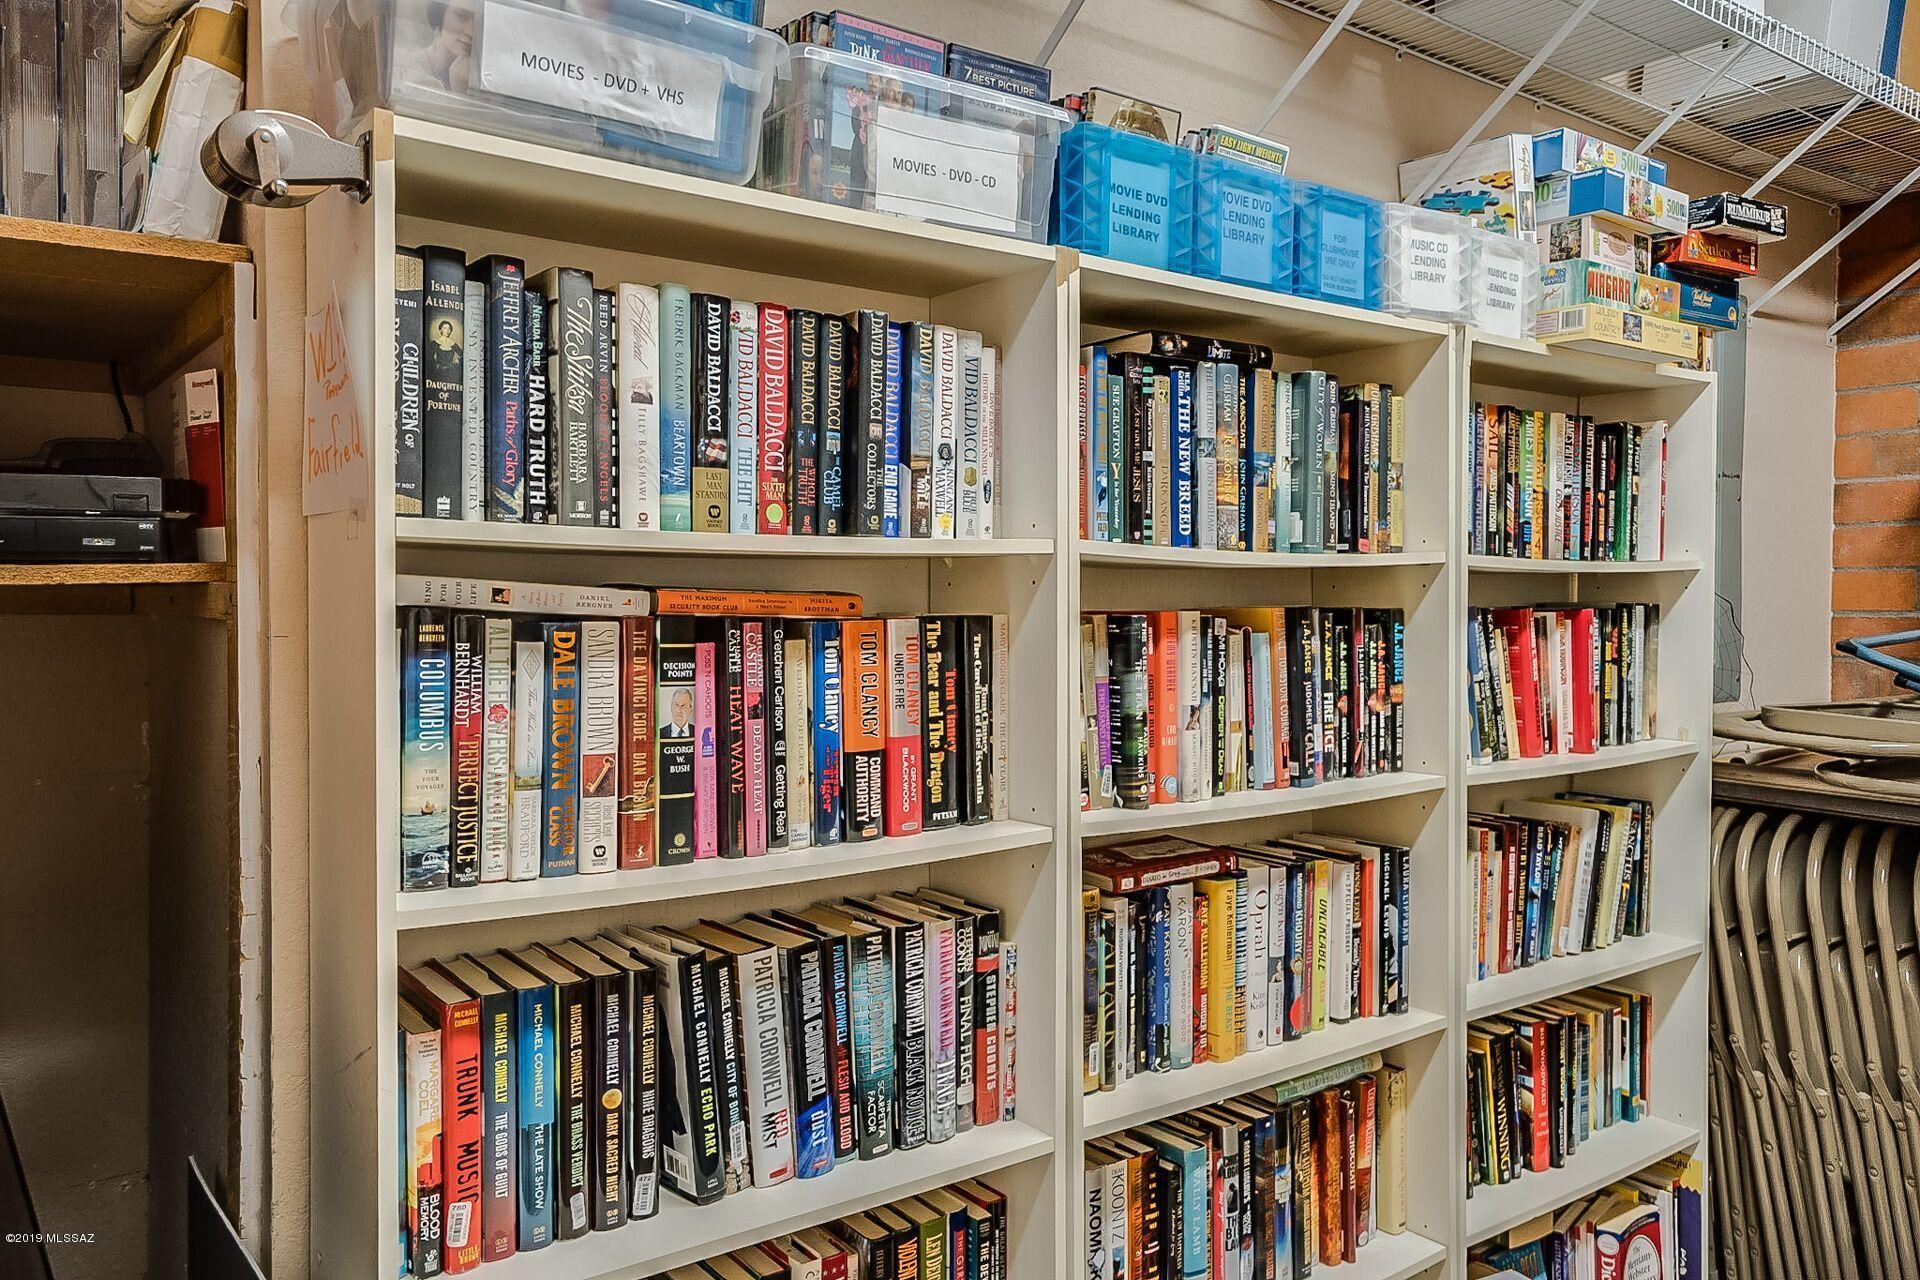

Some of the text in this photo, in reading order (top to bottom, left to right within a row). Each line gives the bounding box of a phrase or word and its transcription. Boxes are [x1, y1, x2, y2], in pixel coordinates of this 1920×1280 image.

[520, 51, 685, 106] MOVIES DVD + VHS
[963, 65, 974, 82] 7
[972, 75, 996, 88] BEST
[997, 79, 1036, 98] PICTURE
[892, 156, 997, 189] MOVIES DVD CD
[1220, 135, 1236, 149] EASY
[1237, 139, 1254, 156] LIGHT
[1255, 144, 1284, 165] WEIGHTS
[1621, 153, 1639, 173] 500
[1112, 204, 1162, 225] LENDING
[1145, 192, 1168, 207] DVD
[1222, 211, 1266, 229] LENDING
[1252, 198, 1272, 213] DVD
[1666, 200, 1680, 216] 500
[1726, 203, 1771, 224] RUMMIKUB
[1112, 222, 1160, 244] LIBRARY
[1222, 226, 1266, 246] LIBRARY
[1321, 243, 1361, 259] CLUBHOUSE
[1325, 256, 1356, 269] USE ONLY
[1333, 234, 1348, 244] FOR
[1436, 242, 1449, 253] CD
[425, 295, 464, 312] ALLENDE
[430, 279, 460, 295] ISABEL
[1410, 269, 1447, 284] LIBRARY
[1509, 272, 1519, 283] CD
[1587, 267, 1632, 306] NIAGARA
[498, 271, 521, 396] JEFFREY ARCHER
[673, 298, 685, 411] FREDRIK BACKMAN
[400, 342, 419, 434] CHILDREN
[438, 391, 450, 401] OF
[706, 301, 722, 433] DAVID BALDACCI
[763, 307, 785, 474] DAVID BALDACCI
[869, 312, 884, 421] DAVID BALDACCI
[427, 400, 461, 413] FORTUNE
[736, 357, 754, 507] BALDACCI THE HIT
[963, 385, 979, 464] BALDACCI
[1111, 384, 1121, 460] SUE GRAFTON
[502, 401, 521, 488] Paths Glory
[528, 374, 546, 507] HARD TRUTH
[569, 421, 578, 484] BARTLETT
[576, 421, 588, 485] BARBARA
[673, 419, 686, 487] BEARTOWN
[1178, 398, 1192, 537] THE NEW BREED
[1223, 434, 1232, 502] RECKONING
[1489, 419, 1499, 459] SAIL
[1524, 415, 1534, 518] JAMES PATTERSON
[705, 471, 723, 481] LAST
[706, 481, 723, 491] MAN
[762, 482, 786, 493] SIXTH
[765, 491, 784, 500] MAN
[865, 442, 878, 511] COLLECTORS
[883, 464, 898, 518] END GAME
[454, 642, 470, 728] BERNHARDT
[469, 653, 483, 715] WILLIAM
[586, 628, 616, 752] SANDRA BROWN
[632, 629, 647, 743] THE DA VINCI CODE
[663, 661, 695, 670] DECISION
[667, 669, 693, 678] POINTS
[773, 629, 785, 732] Gretchen Carlson
[859, 630, 880, 738] TOM CLANCY
[894, 653, 906, 710] UNDER FIRE
[417, 657, 446, 753] COLUMBUS
[550, 630, 577, 791] DALE BROWN
[926, 620, 945, 804] The Bear and The Dragon
[1323, 692, 1334, 723] FIRE
[663, 745, 694, 755] GEORGE
[669, 763, 691, 774] BUSH
[675, 755, 686, 764] W.
[729, 684, 744, 794] HEAT WAVE
[773, 764, 787, 837] Getting Real
[855, 754, 870, 823] AUTHORITY
[869, 756, 881, 819] COMMAND
[456, 797, 479, 865] JUSTICE
[1622, 820, 1638, 881] SANCTUS
[1177, 896, 1187, 950] KARON
[1225, 889, 1234, 962] Faye Kellerman
[1250, 889, 1267, 961] Oprah
[1318, 898, 1328, 972] UNLIKEABLE
[495, 1013, 508, 1104] MICHAEL CONNELLY
[533, 1003, 544, 1109] MICHAEL CONNELLY
[753, 954, 783, 1109] PATRICIA CORNWELL
[803, 1023, 826, 1102] CORNWELL
[985, 974, 997, 1091] STEPHEN COONTS
[456, 1053, 478, 1120] TRUNK
[836, 1059, 852, 1151] FLESH AND BLOOD
[866, 1090, 877, 1135] FACTOR
[699, 1086, 718, 1157] ECHO PARK
[810, 1109, 828, 1148] dust
[1497, 1096, 1511, 1170] WINNING
[456, 1142, 479, 1205] MUSIC
[605, 1112, 619, 1203] DARK SACRED NIGHT
[420, 1195, 429, 1242] MEMORY
[429, 1193, 440, 1240] BLOOD
[1089, 1188, 1102, 1252] NAOMI
[1111, 1173, 1125, 1245] KOONTZ
[1193, 1166, 1203, 1256] WALLY LAMB
